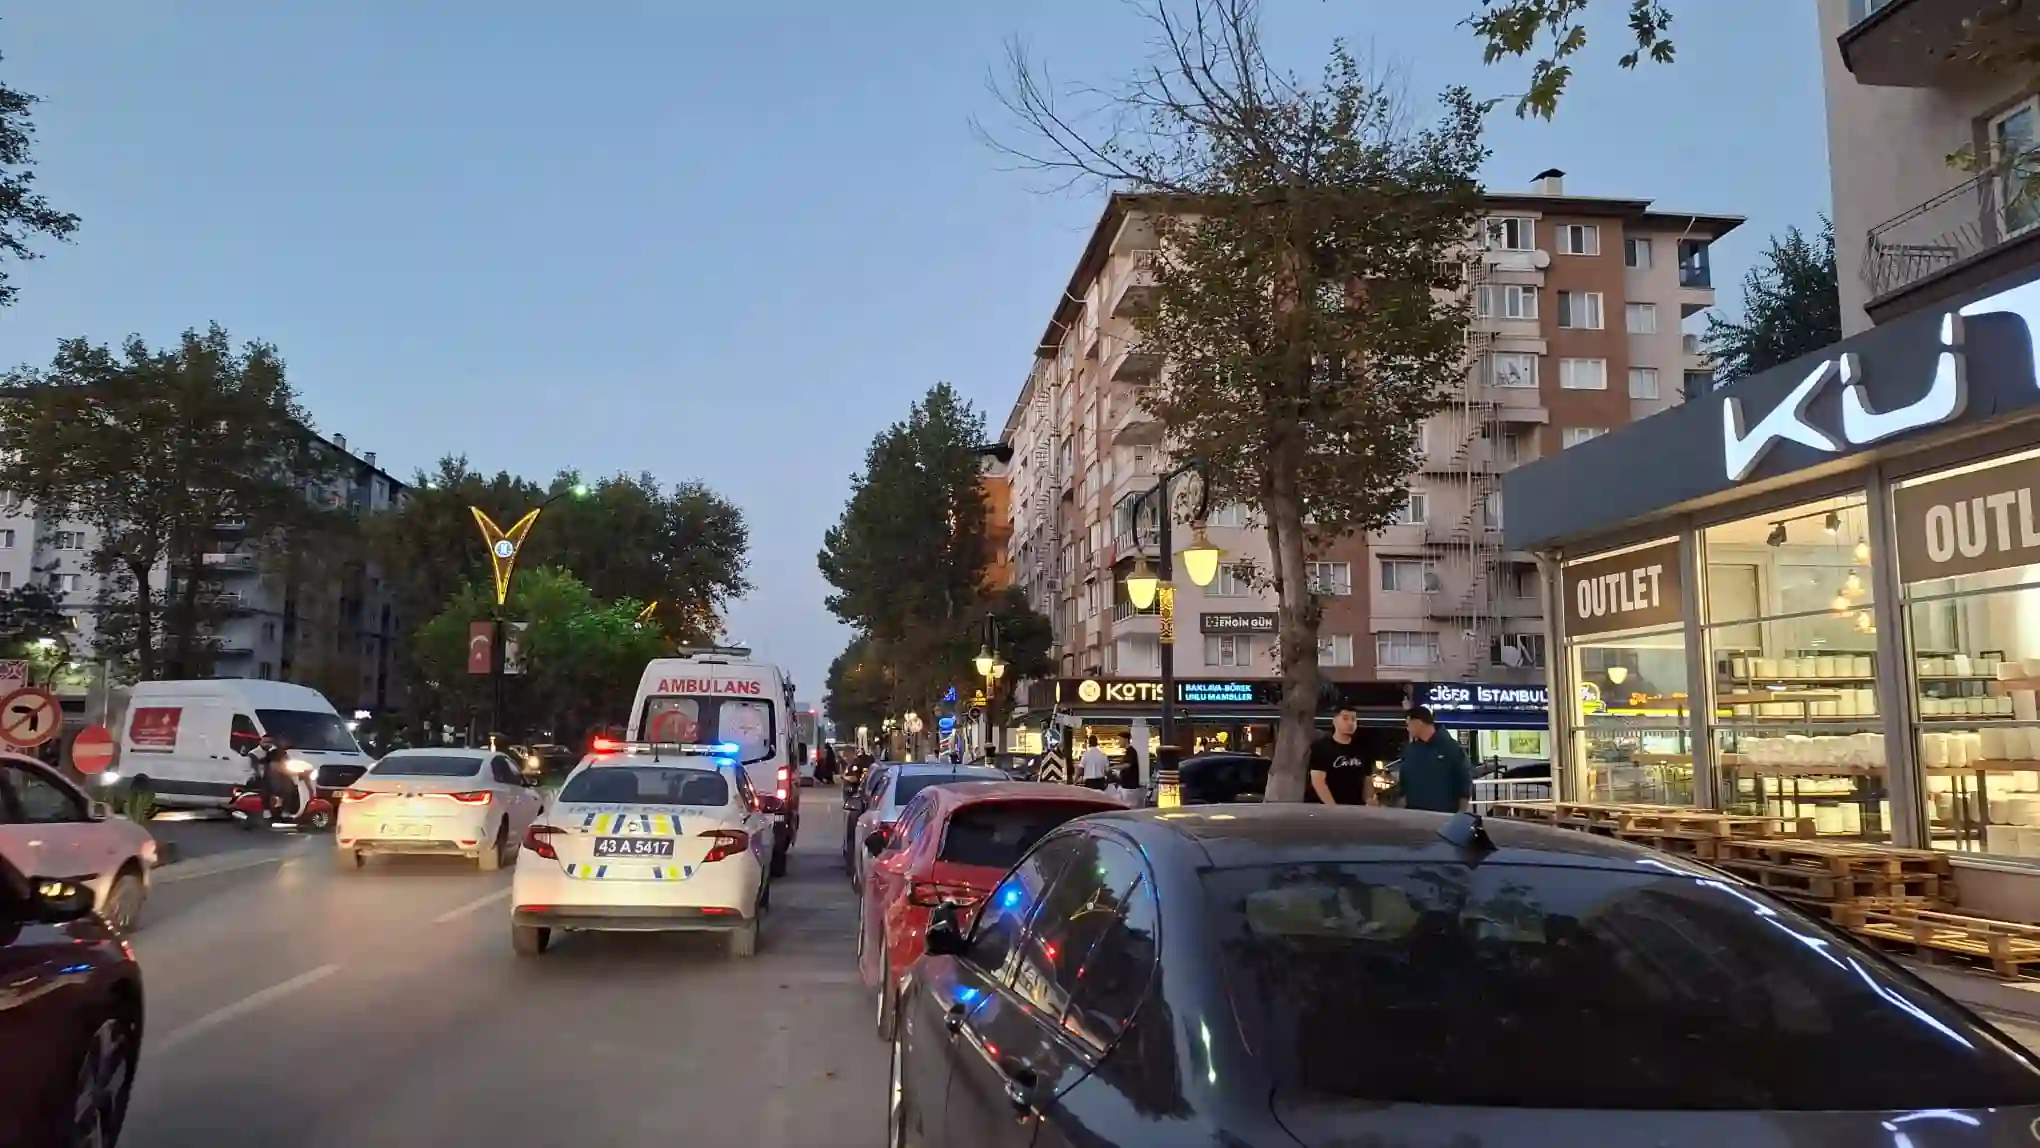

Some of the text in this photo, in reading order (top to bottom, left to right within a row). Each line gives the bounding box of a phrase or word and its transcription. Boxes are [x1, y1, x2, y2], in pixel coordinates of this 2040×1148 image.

[1577, 564, 1662, 618] OUTLET
[657, 678, 761, 695] AMBULANS
[599, 839, 670, 854] 43 A 5417
